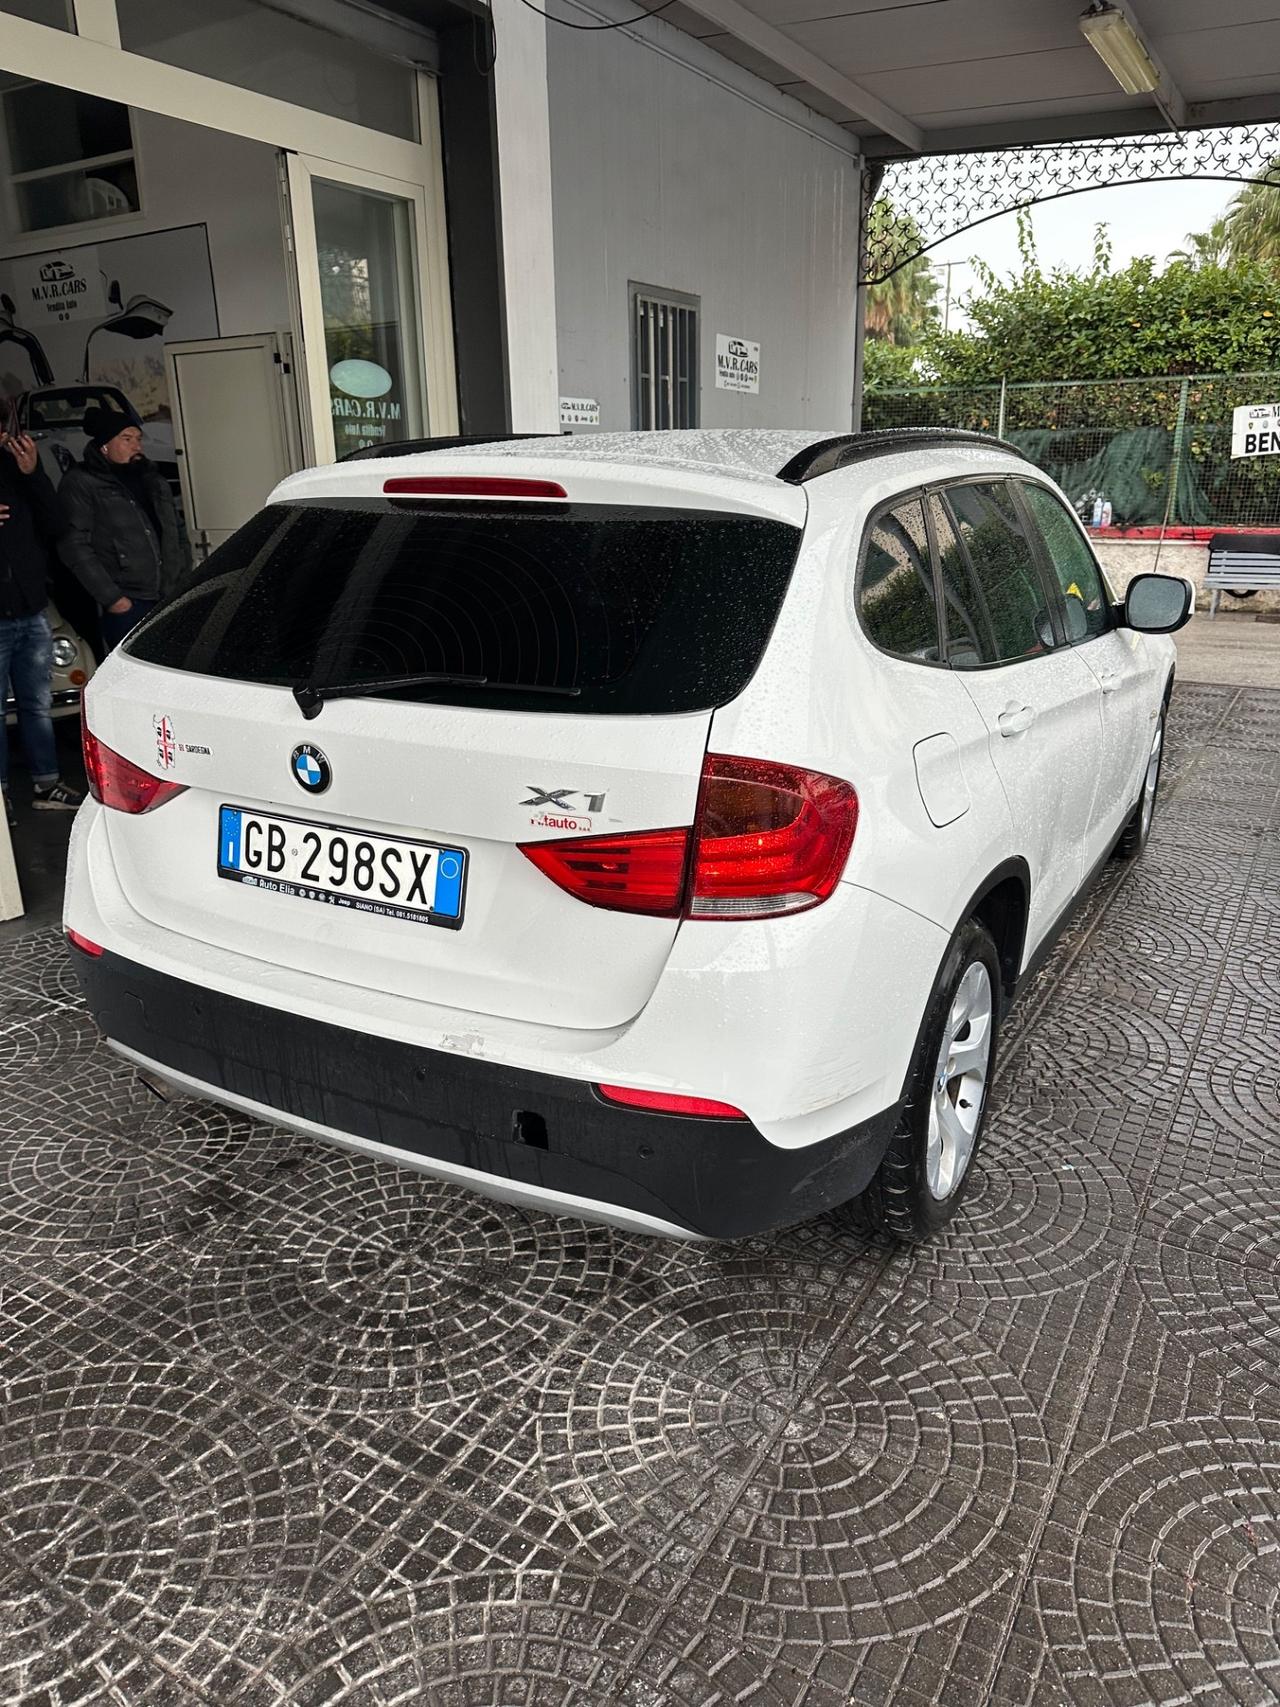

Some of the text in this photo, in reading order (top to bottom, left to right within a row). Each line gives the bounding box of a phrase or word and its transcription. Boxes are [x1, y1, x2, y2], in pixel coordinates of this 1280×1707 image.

[32, 278, 87, 301] M.V.R.CARS
[293, 745, 326, 764] BMW
[518, 785, 606, 813] X1
[260, 879, 295, 895] Auto Elia
[355, 902, 373, 912] SIANO
